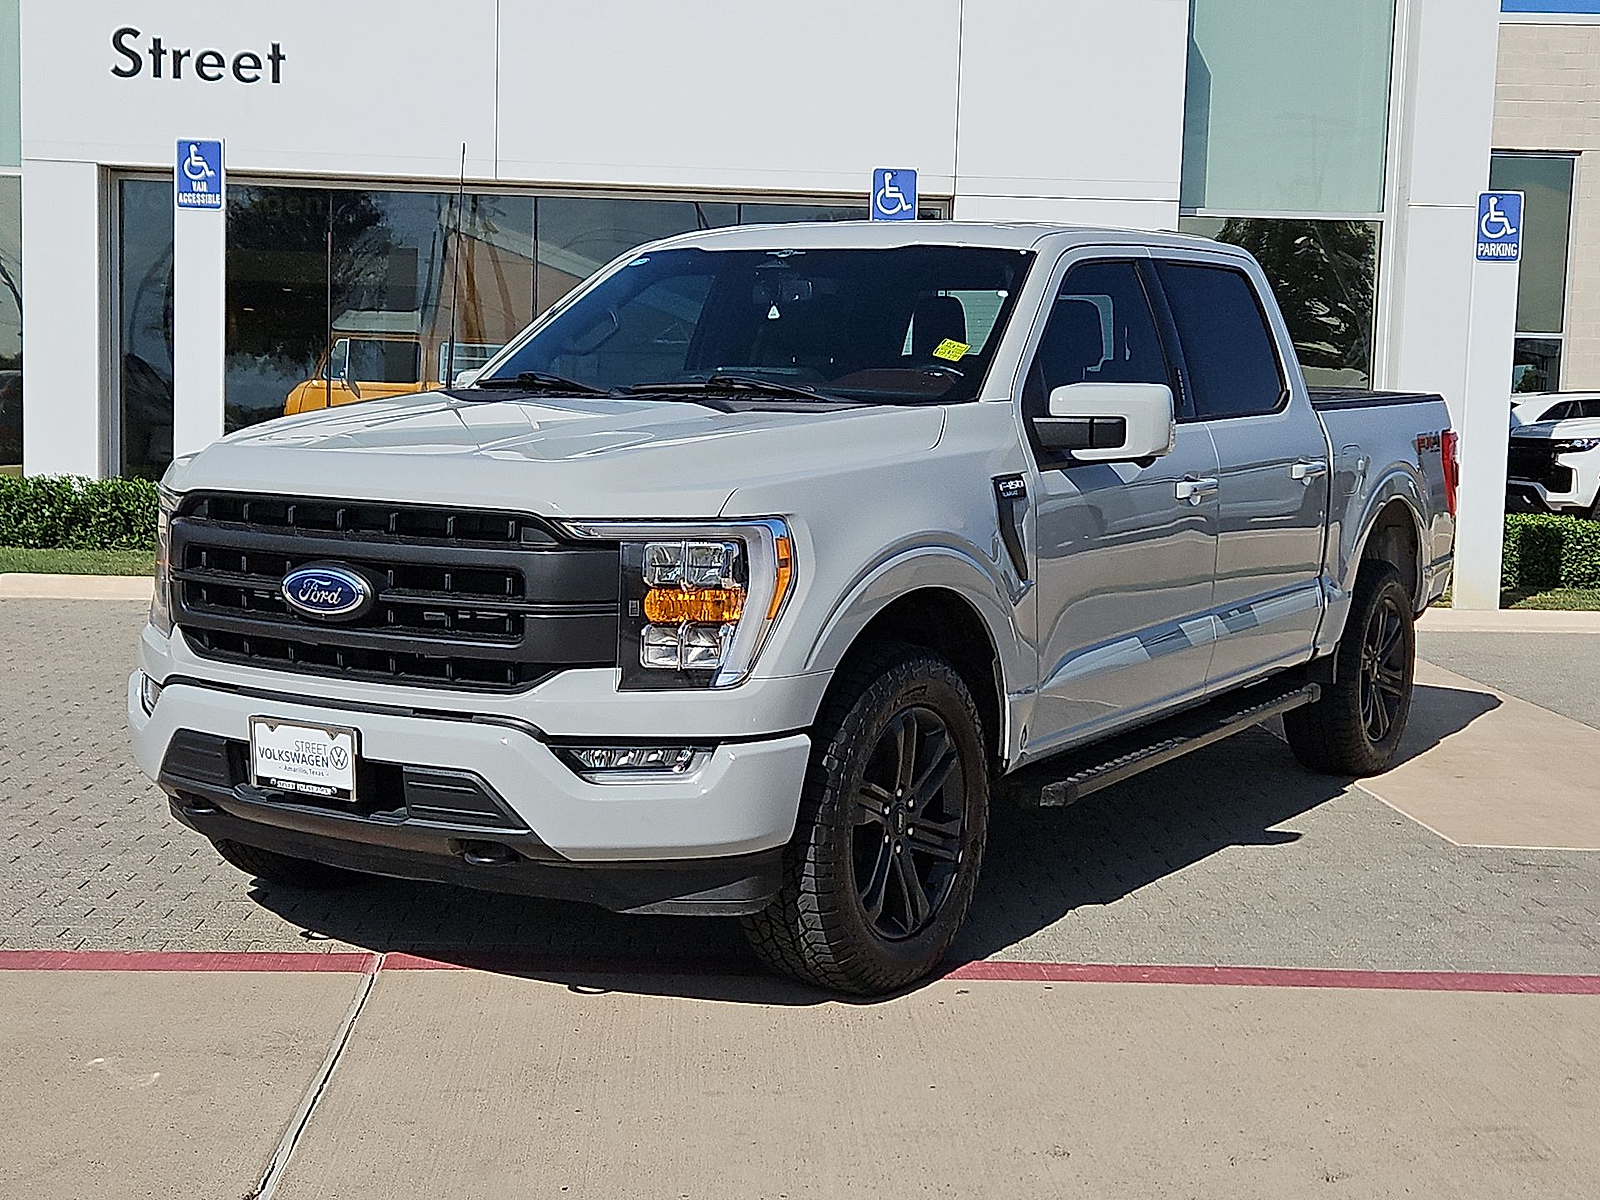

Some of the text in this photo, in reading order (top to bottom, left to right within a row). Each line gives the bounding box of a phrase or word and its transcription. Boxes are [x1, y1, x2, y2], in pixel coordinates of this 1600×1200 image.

[110, 26, 286, 84] Street
[191, 180, 208, 192] VAN
[178, 192, 221, 205] ACCESSIBLE
[1477, 242, 1518, 257] PARKING
[299, 578, 342, 604] Ford
[294, 740, 328, 756] STREET
[258, 746, 329, 768] VOLKSWAGEN
